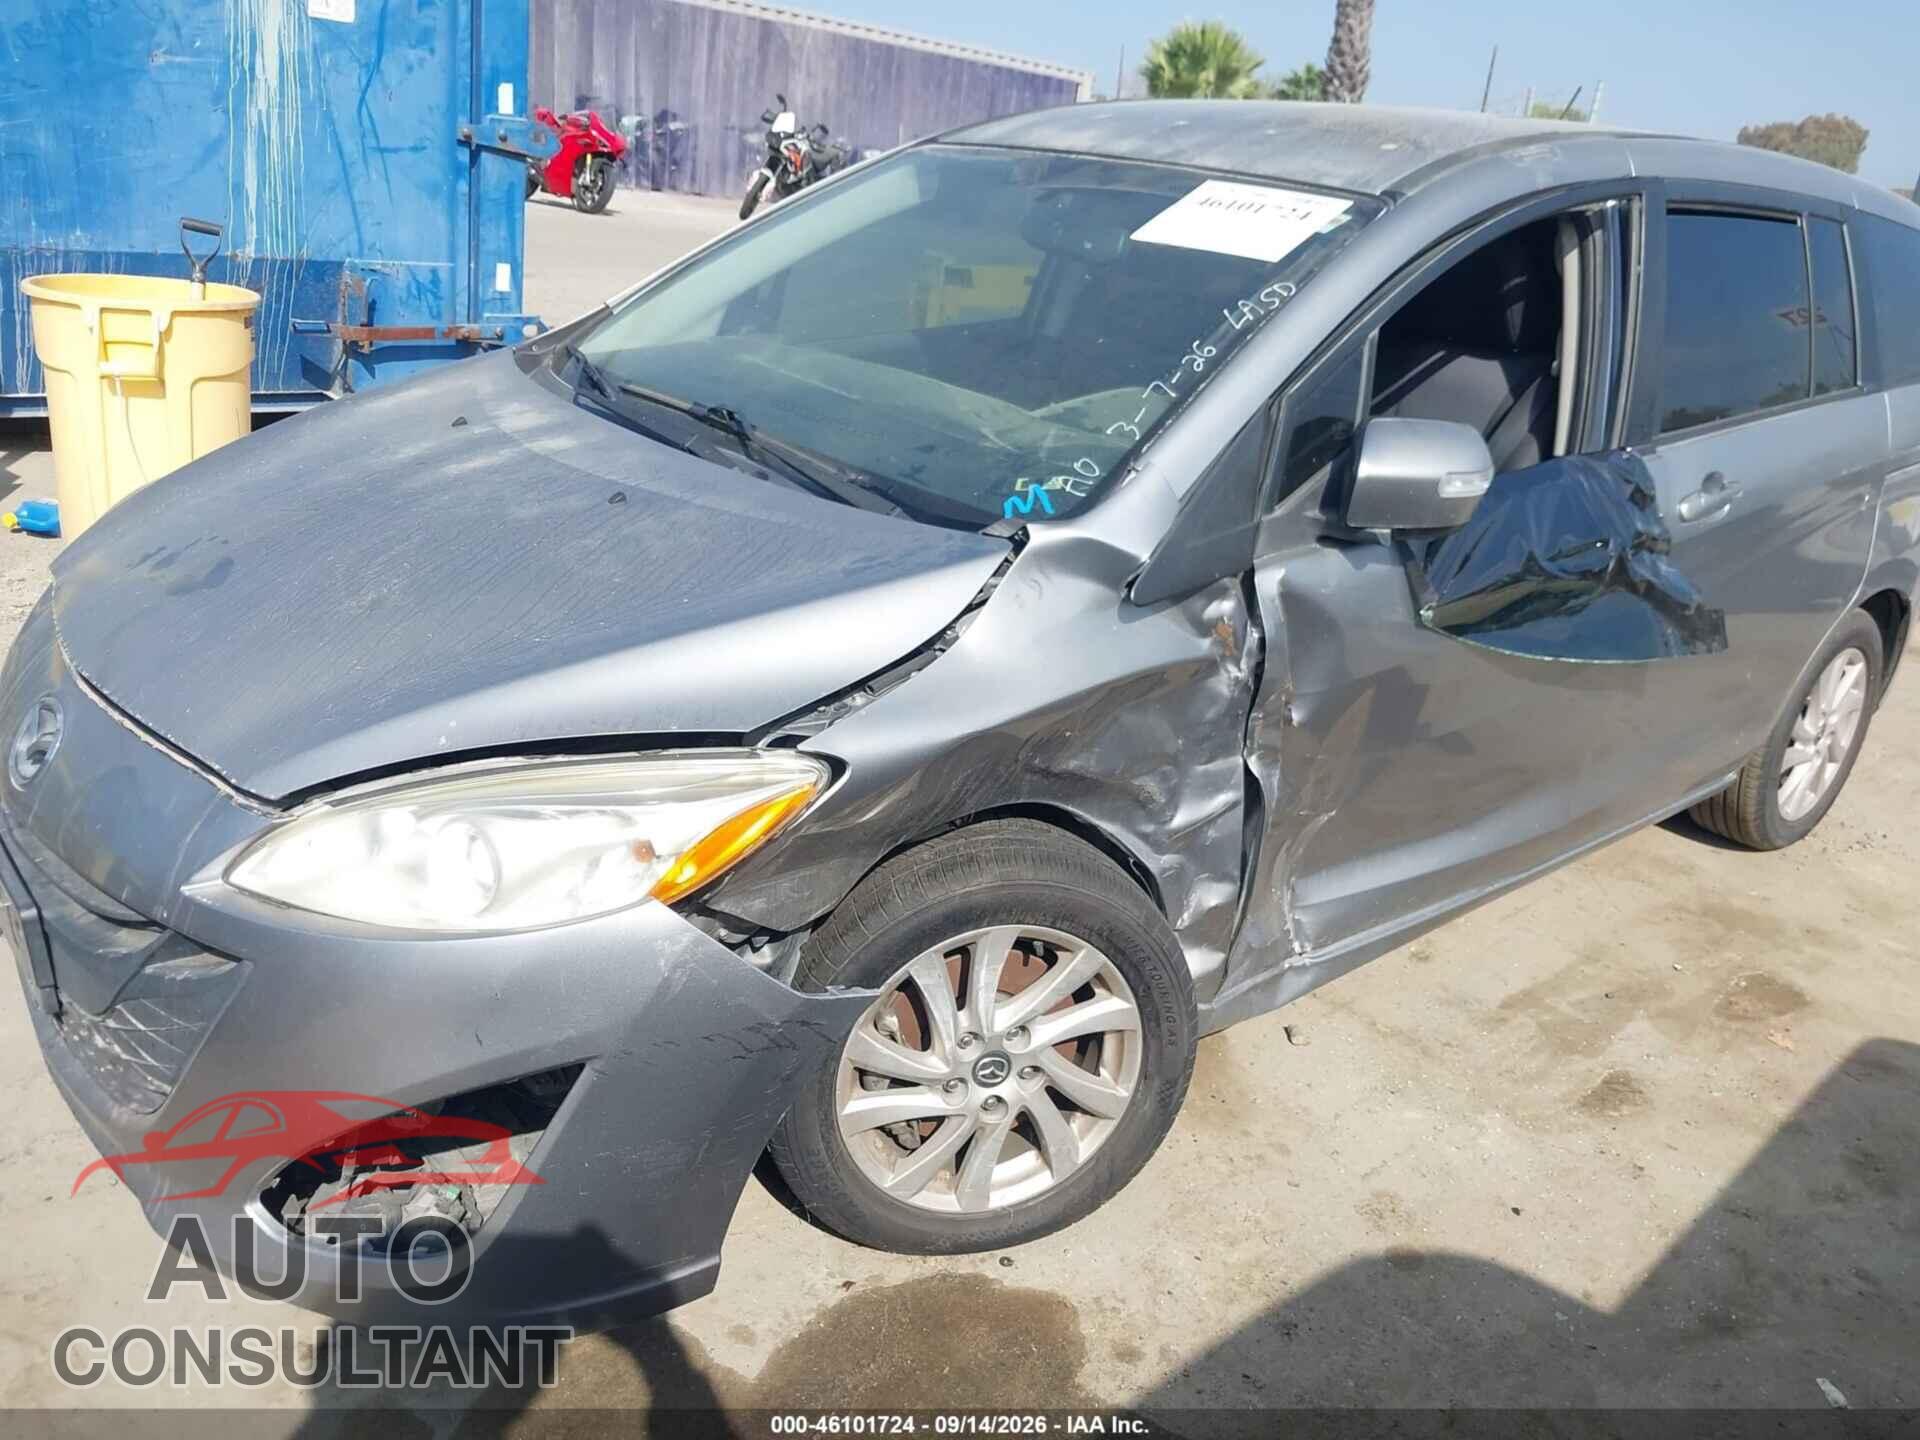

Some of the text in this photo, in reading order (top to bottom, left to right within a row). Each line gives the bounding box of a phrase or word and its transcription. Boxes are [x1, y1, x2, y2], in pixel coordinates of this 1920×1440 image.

[1106, 340, 1217, 441] 3-7-26
[1223, 281, 1297, 330] LASD
[1003, 484, 1055, 519] M
